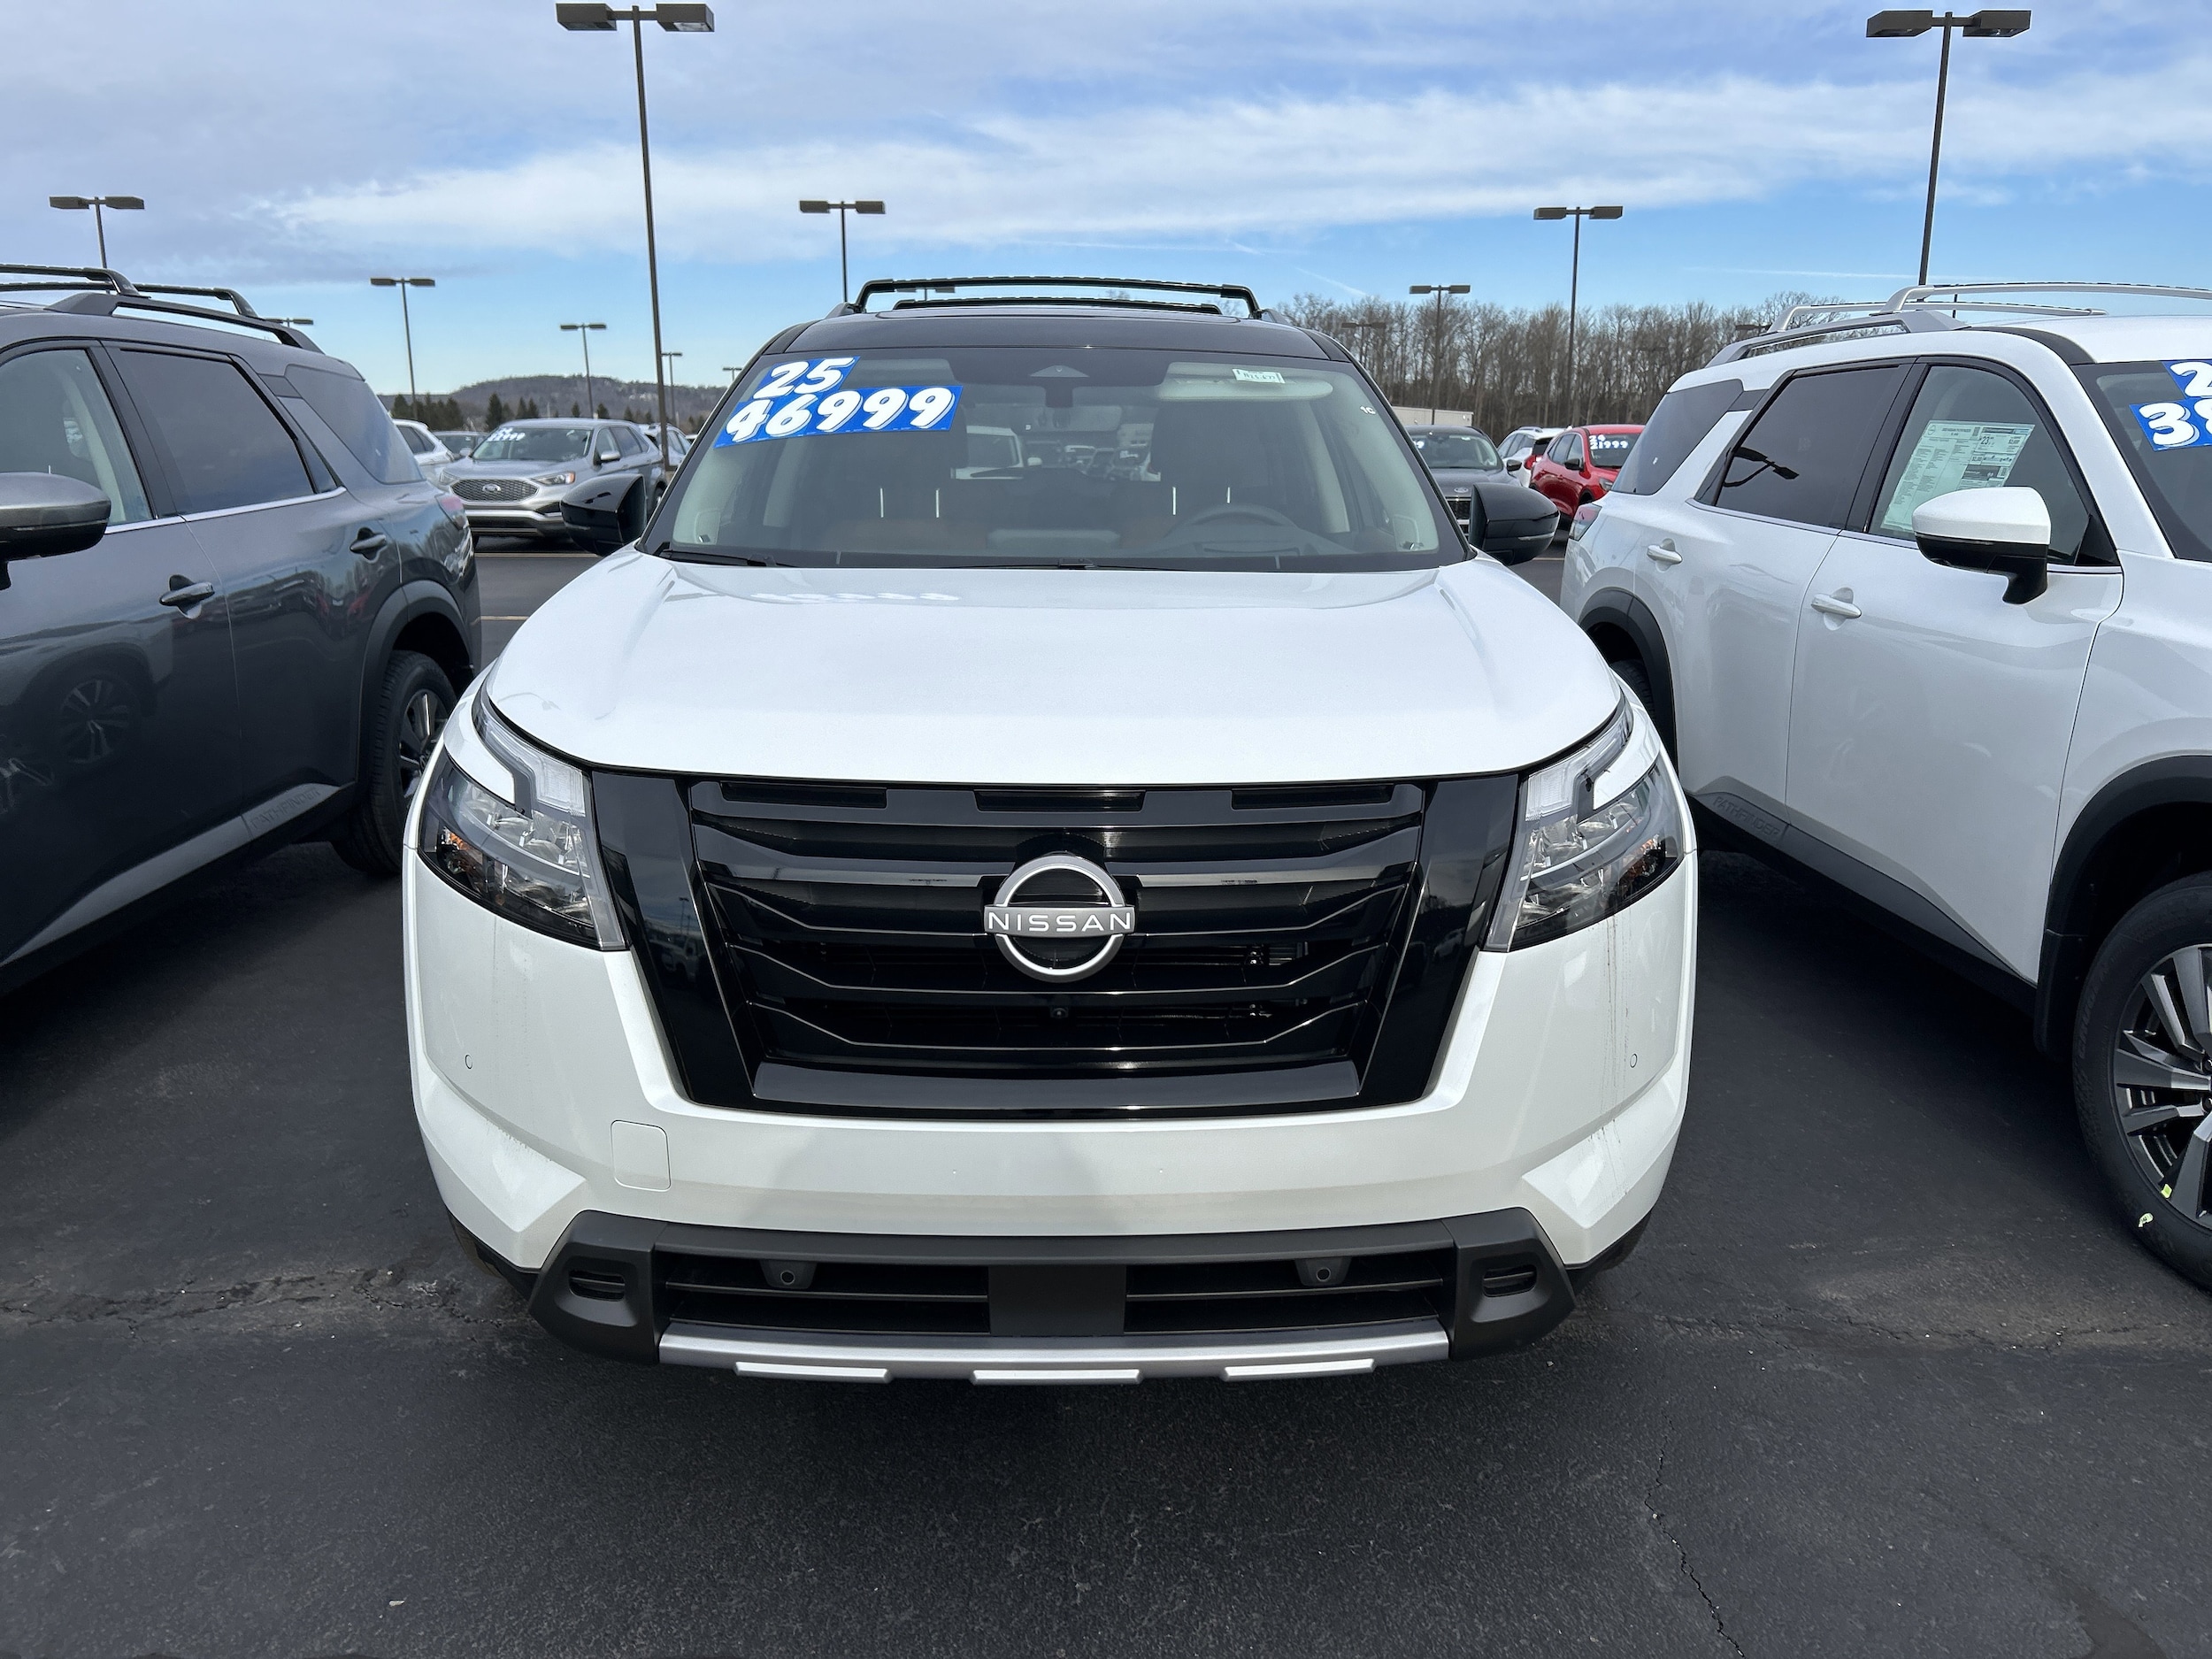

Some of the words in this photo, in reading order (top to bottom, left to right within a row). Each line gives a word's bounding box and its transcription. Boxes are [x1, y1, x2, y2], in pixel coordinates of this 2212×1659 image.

[753, 357, 856, 399] 25
[726, 388, 956, 442] 46999
[988, 911, 1131, 933] NISSAN
